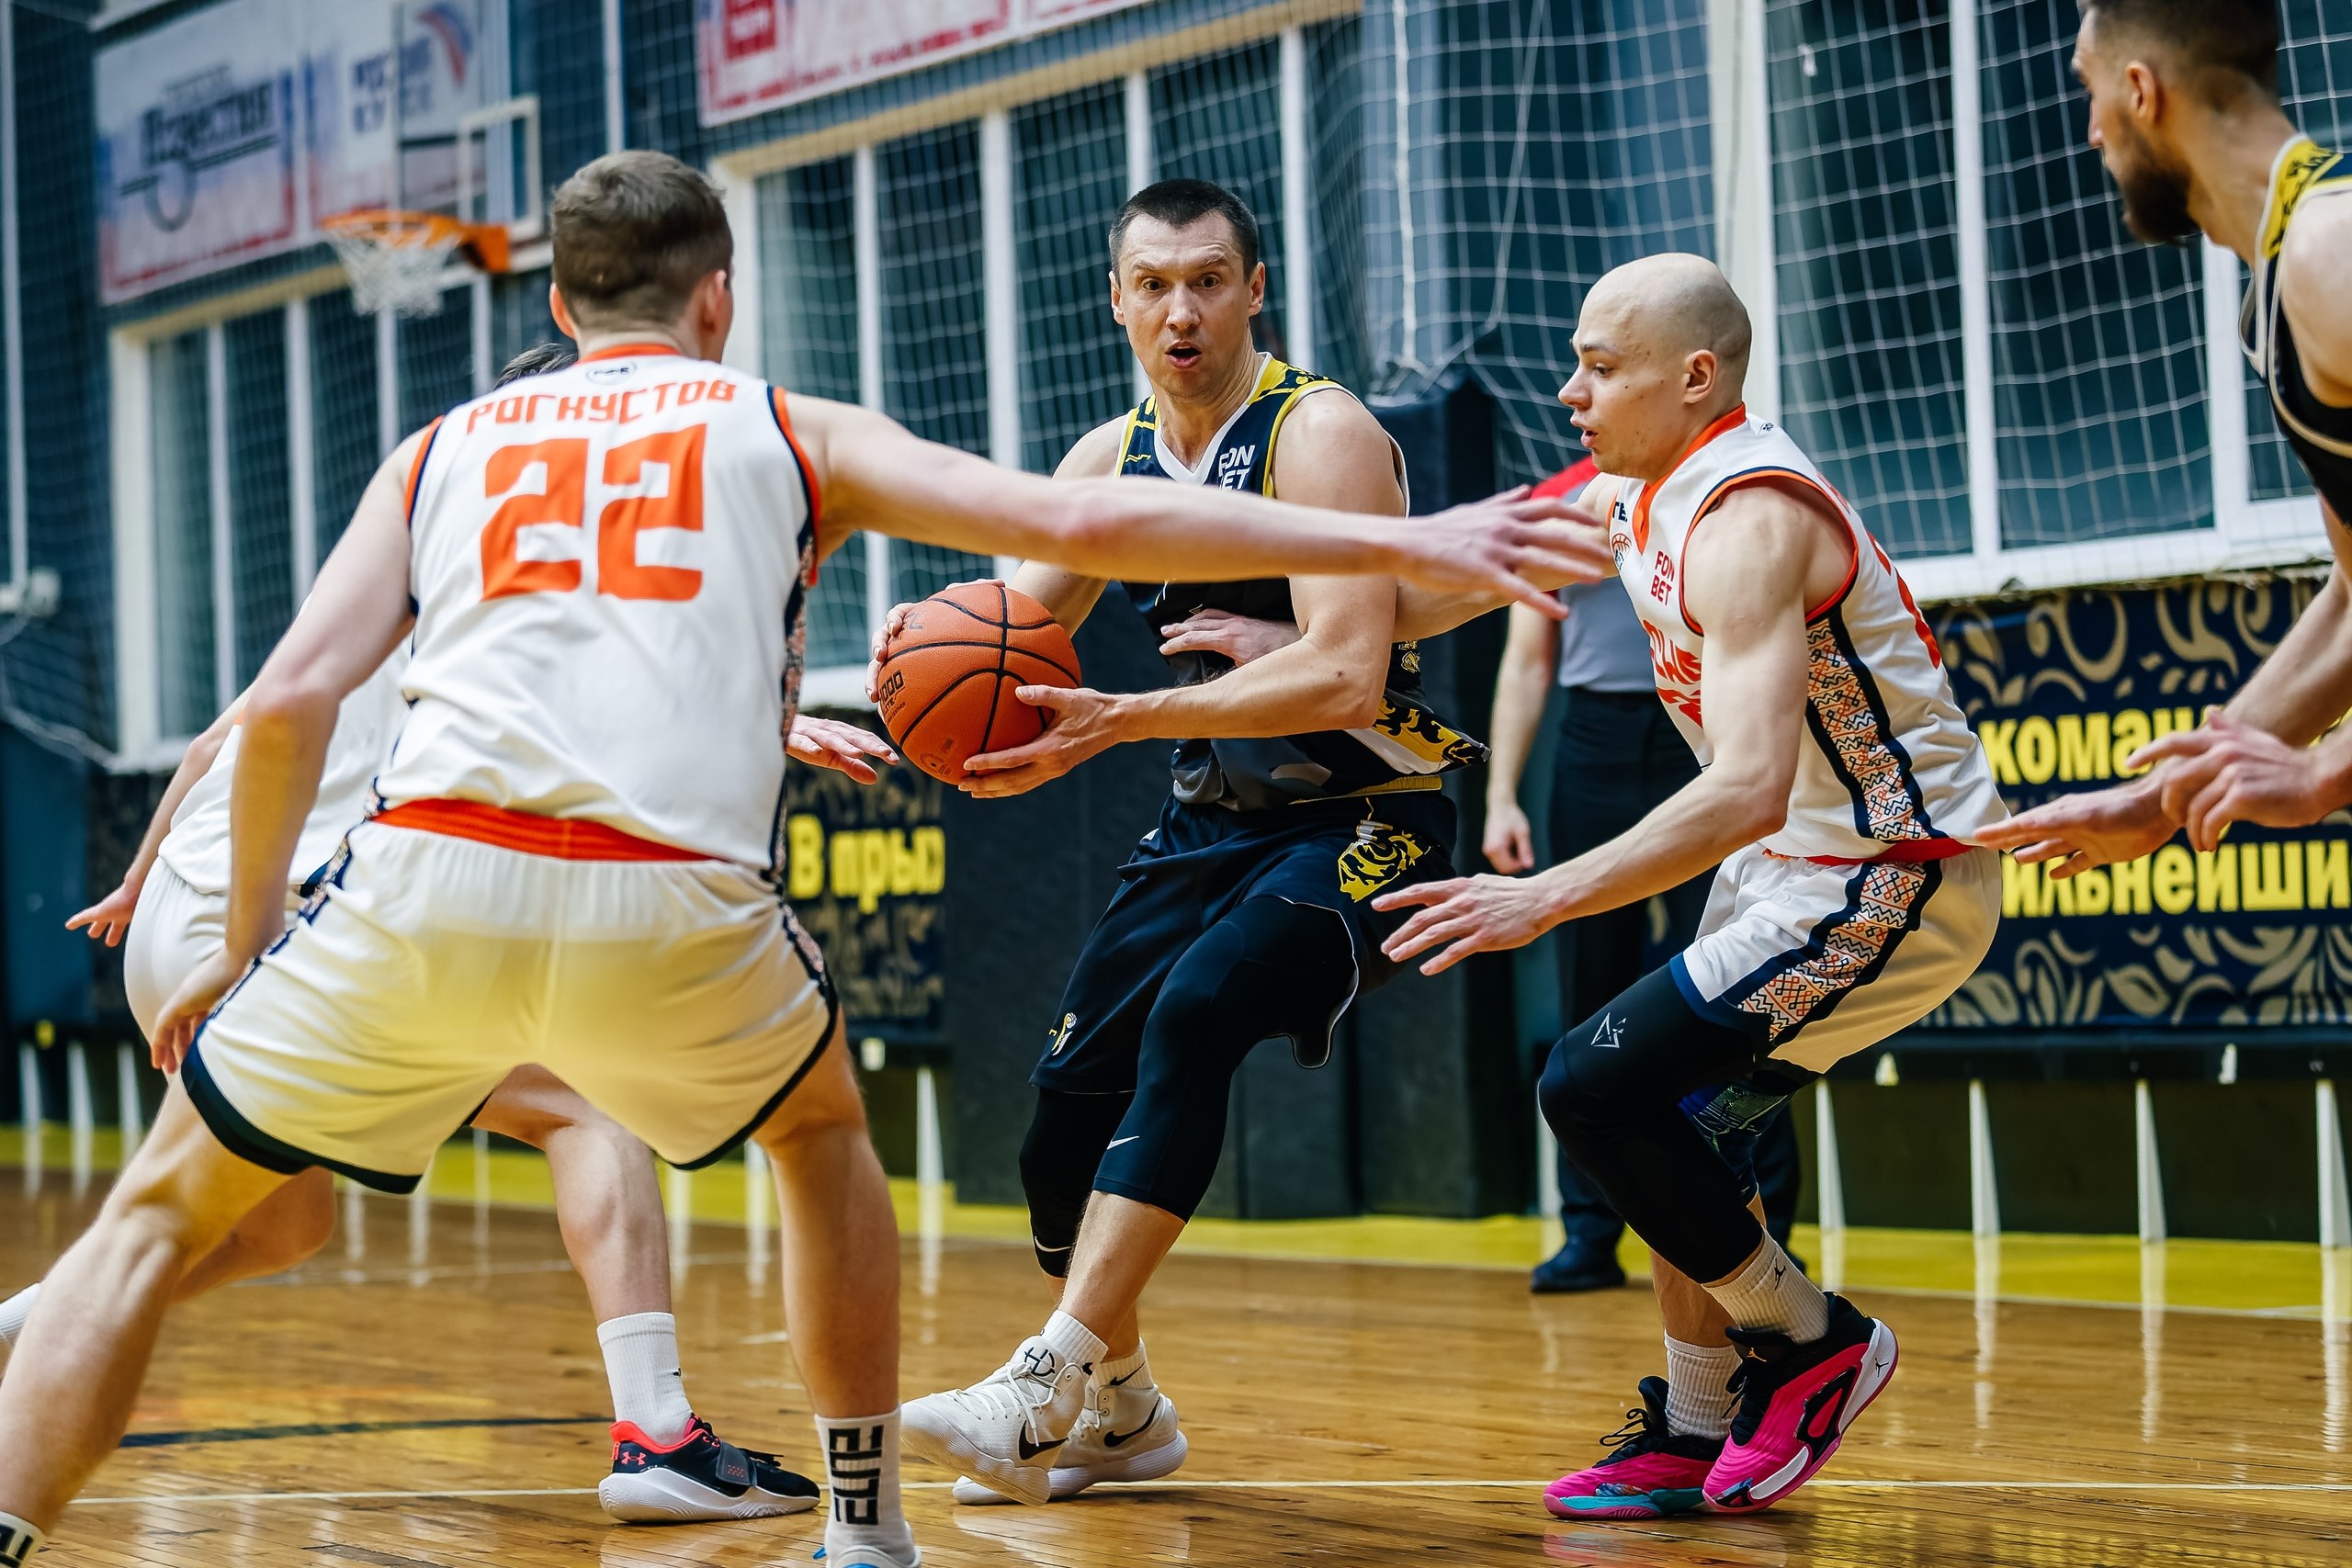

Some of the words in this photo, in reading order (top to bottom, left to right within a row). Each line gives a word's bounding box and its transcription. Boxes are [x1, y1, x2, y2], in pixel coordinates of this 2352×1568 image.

[479, 423, 707, 604] 22
[1650, 574, 1672, 606] BET
[1655, 551, 1675, 581] FON
[788, 813, 825, 900] В
